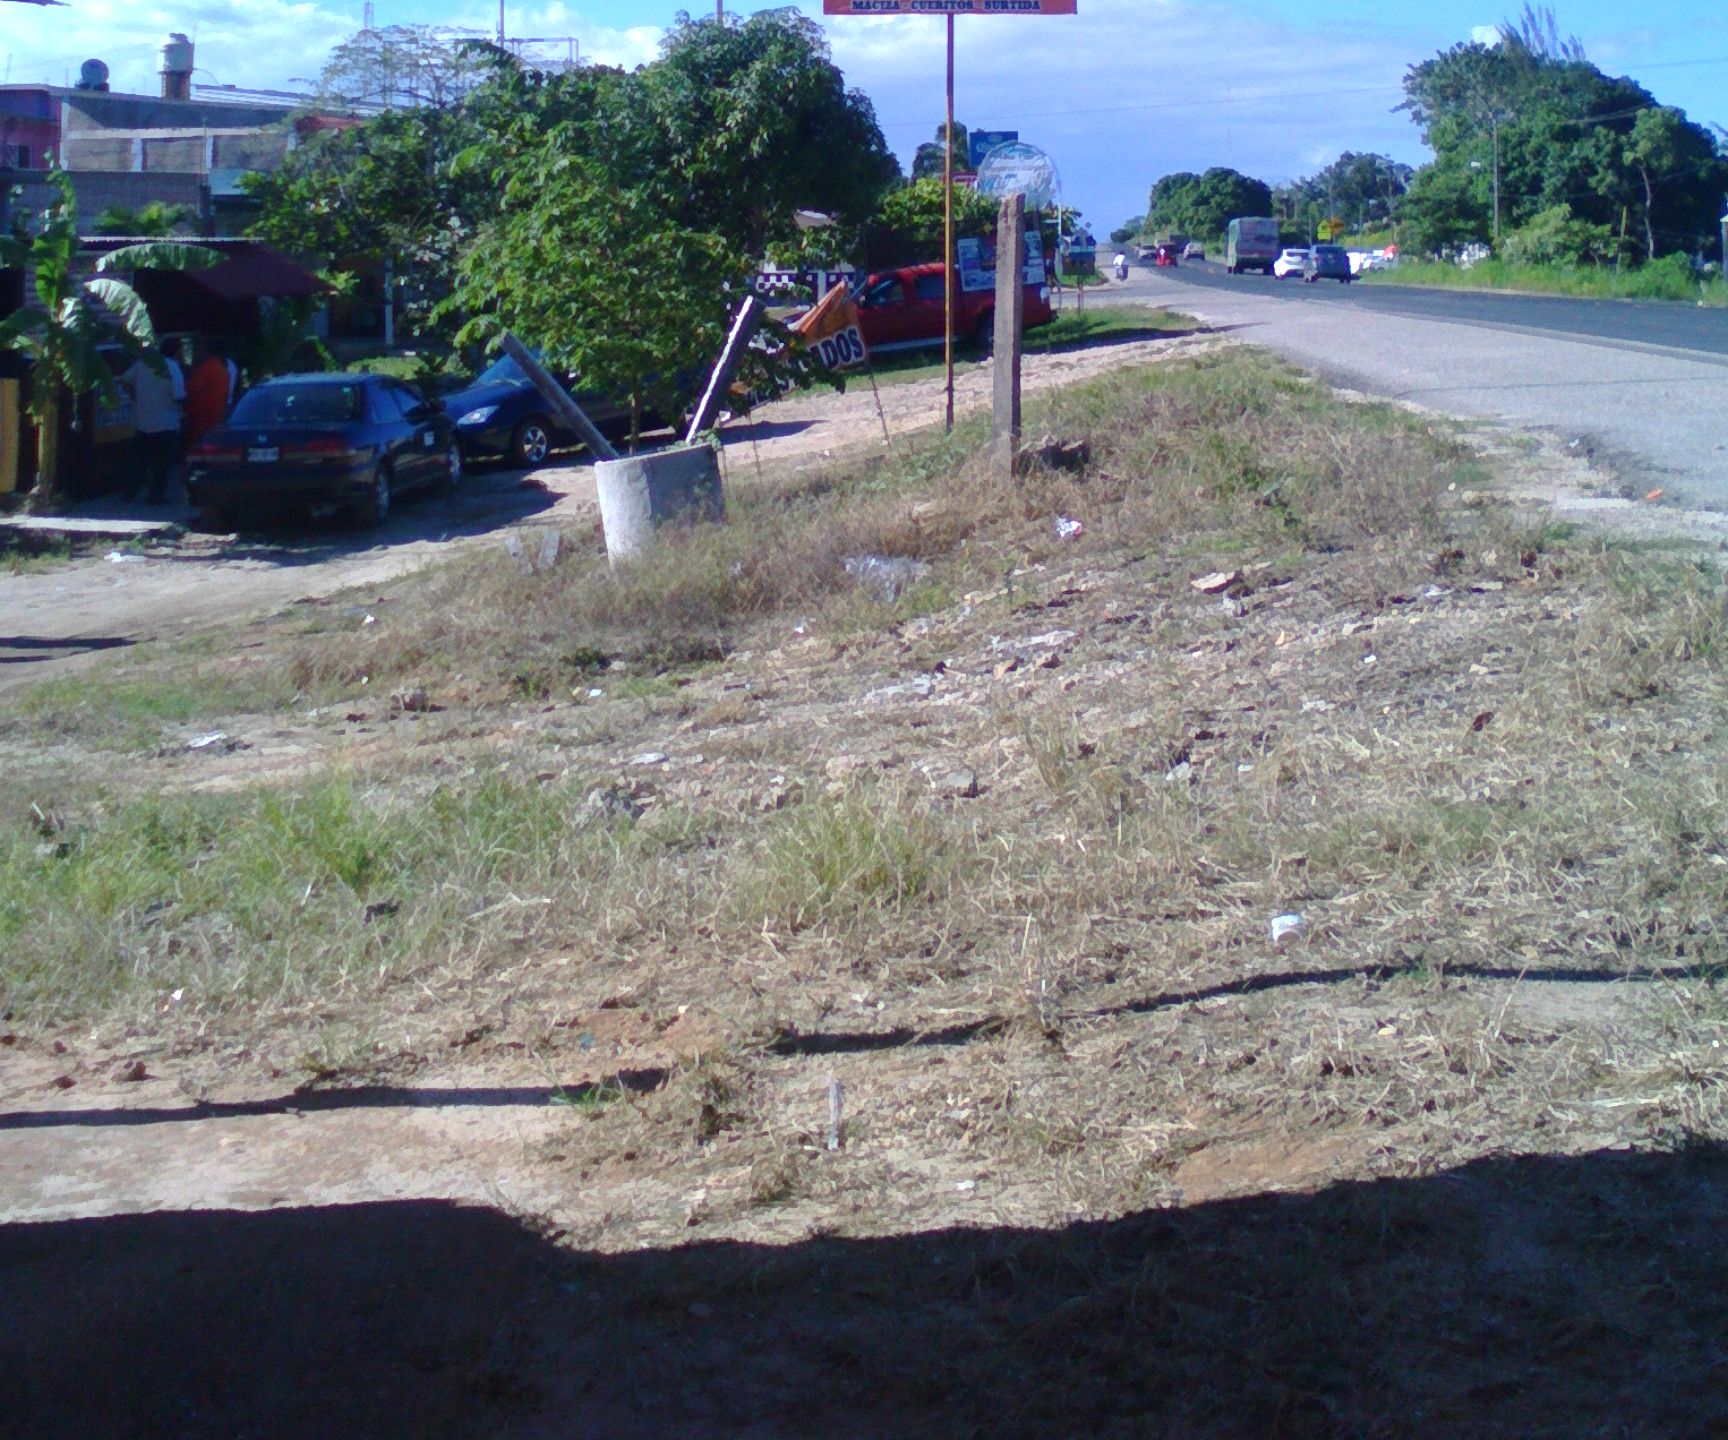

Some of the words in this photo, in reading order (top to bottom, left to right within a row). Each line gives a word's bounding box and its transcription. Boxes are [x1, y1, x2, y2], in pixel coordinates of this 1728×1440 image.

[852, 0, 900, 10] MACIZA
[911, 0, 974, 10] CUERITOS
[984, 0, 1041, 10] SURTIDA
